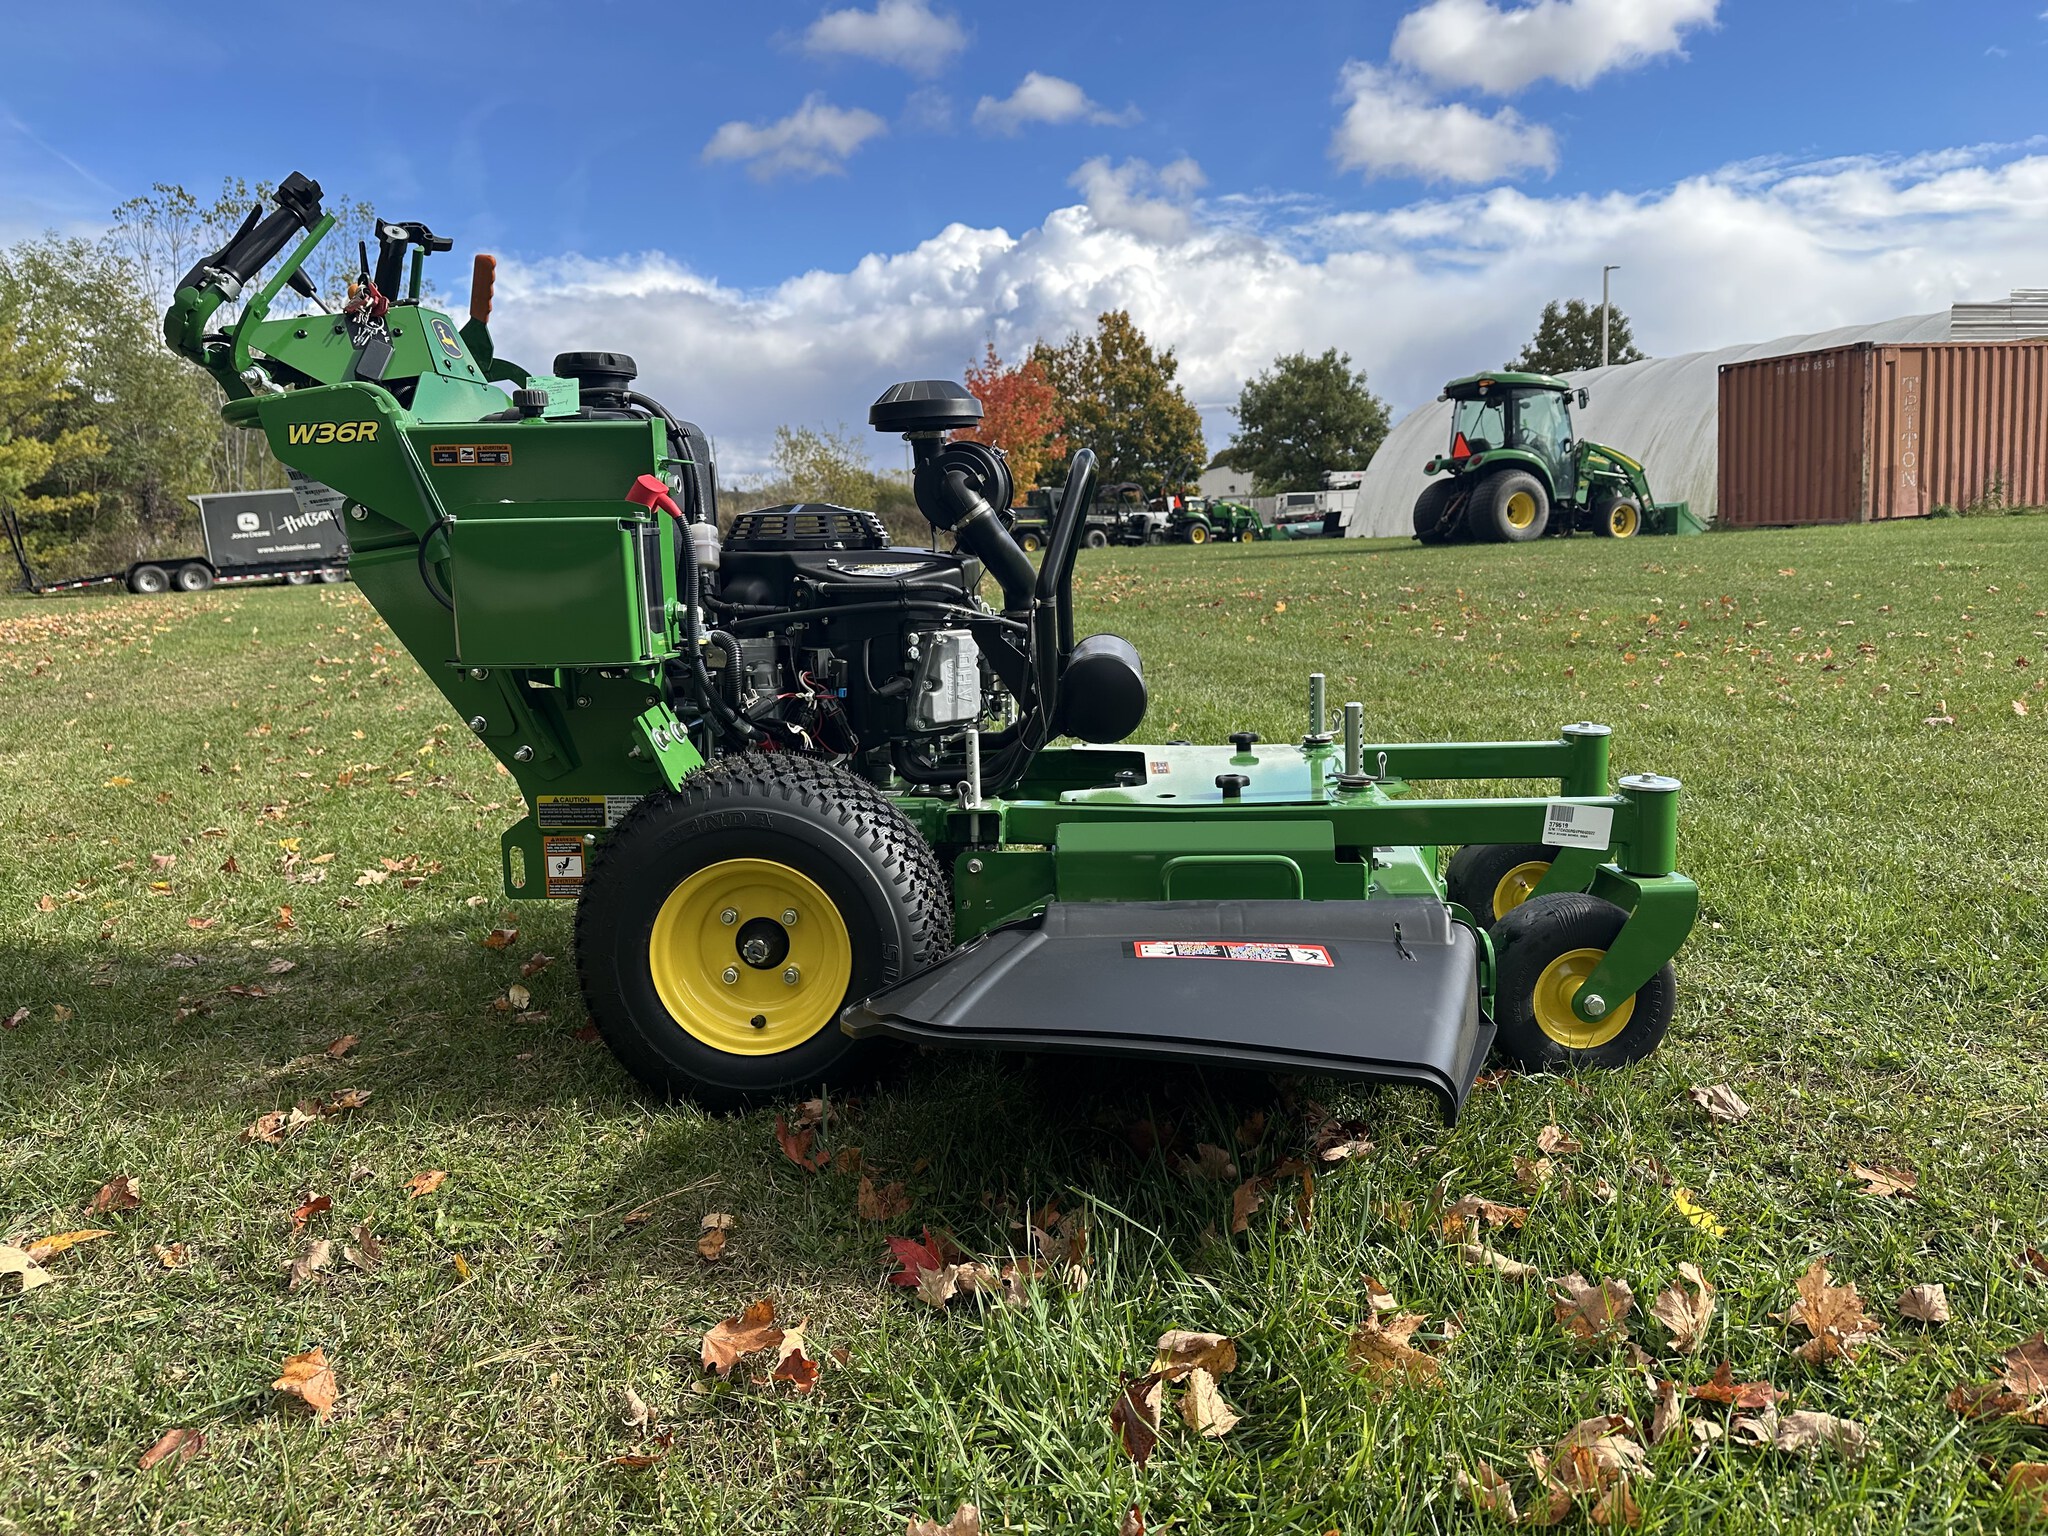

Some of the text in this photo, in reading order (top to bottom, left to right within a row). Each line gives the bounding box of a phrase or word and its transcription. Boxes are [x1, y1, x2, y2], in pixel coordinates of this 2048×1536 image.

[288, 422, 379, 445] W36R
[1902, 376, 1919, 487] TRITON
[277, 509, 340, 535] Hutson
[231, 530, 271, 540] JOHN DEERE
